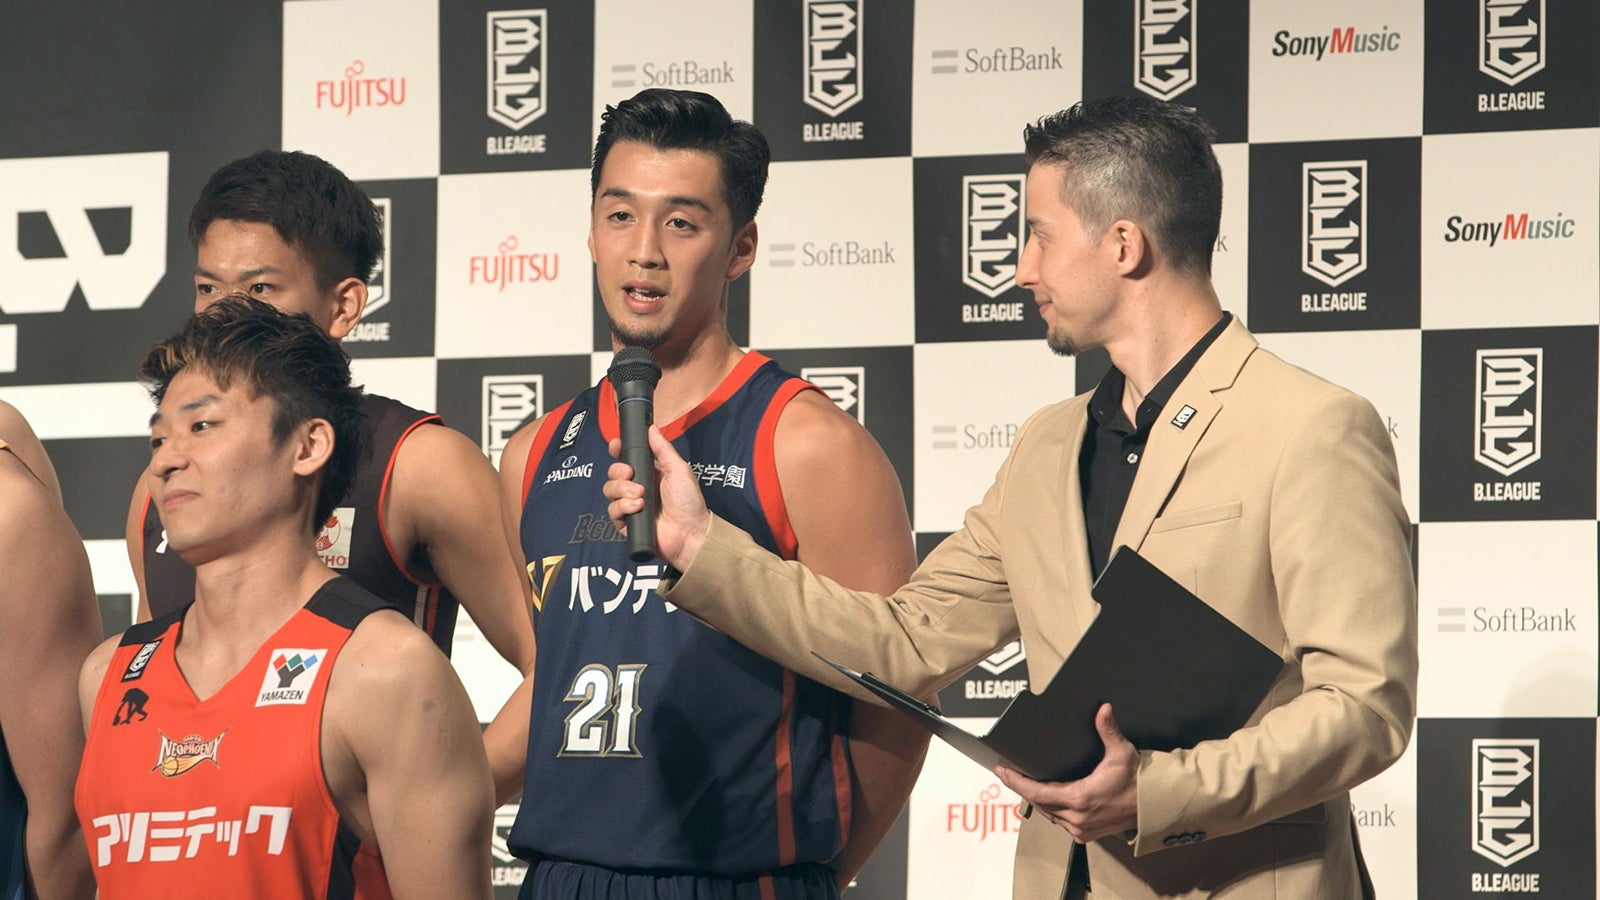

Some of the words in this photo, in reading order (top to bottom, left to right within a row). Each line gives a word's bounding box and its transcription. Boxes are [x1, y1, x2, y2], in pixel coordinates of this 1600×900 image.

[964, 46, 1064, 74] SoftBank
[641, 60, 735, 88] SoftBank
[316, 76, 407, 117] FUJITSU
[1477, 91, 1546, 113] B.LEAGUE
[486, 134, 547, 155] B.LEAGUE
[803, 121, 864, 142] B.LEAGUE
[801, 240, 896, 267] SoftBank
[469, 251, 560, 292] FUJITSU
[962, 303, 1024, 323] B.LEAGUE
[1301, 292, 1367, 313] B.LEAGUE
[964, 423, 1019, 449] SoftB
[543, 462, 594, 485] PALDING
[687, 461, 747, 489] 学園
[1474, 481, 1542, 502] B.LEAGUE
[1472, 606, 1577, 633] SoftBank
[261, 690, 304, 702] YAMAZEN
[557, 663, 648, 758] 21
[156, 732, 227, 767] NEOPHOENIX
[92, 805, 293, 867] アツミテック
[946, 803, 1022, 842] FUJITS
[1471, 872, 1540, 893] B.LEAGUE
